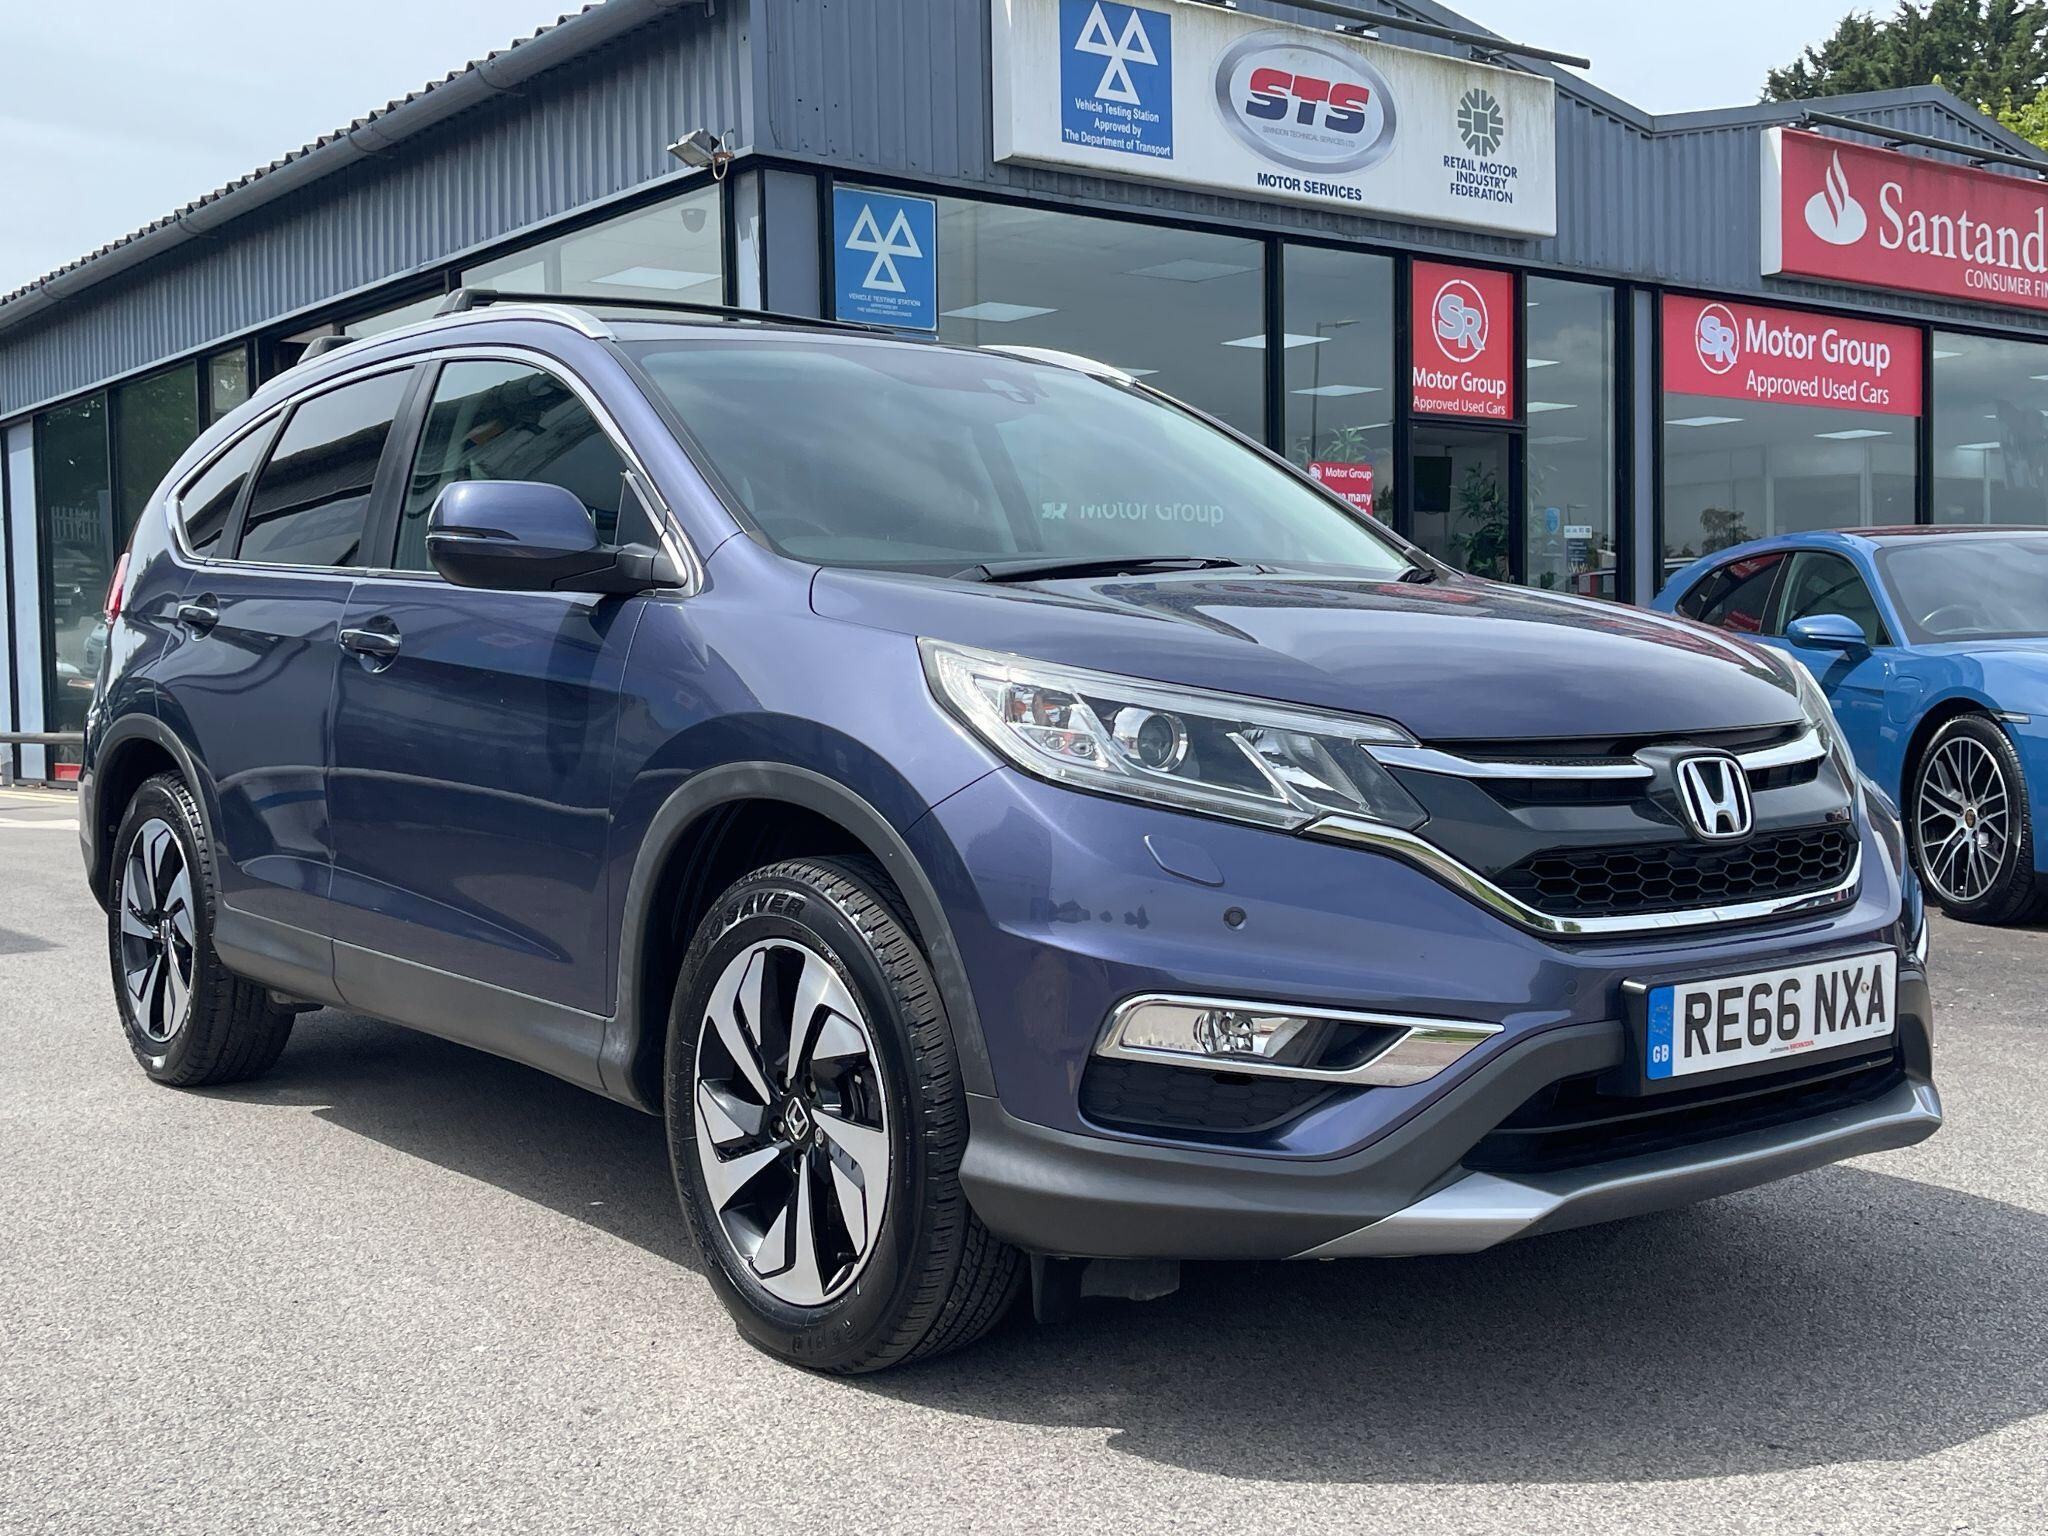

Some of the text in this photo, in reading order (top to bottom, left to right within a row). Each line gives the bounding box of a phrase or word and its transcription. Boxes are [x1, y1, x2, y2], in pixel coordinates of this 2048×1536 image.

[1074, 97, 1160, 123] Vehicle Testing Station
[1246, 68, 1370, 134] STS
[1094, 117, 1142, 138] Approved by
[1064, 128, 1171, 156] The Department of Transport
[1443, 155, 1518, 179] RETAIL MOTOR
[1456, 170, 1508, 189] INDUSTRY
[1257, 172, 1363, 201] MOTOR SERVICES
[1450, 182, 1513, 204] FEDERATION
[1965, 268, 2032, 296] CONSUMER
[849, 292, 921, 307] VEHICLE TESTING STATION
[1746, 318, 1816, 360] Motor
[1822, 328, 1890, 376] Group
[1413, 366, 1506, 399] Motor Group
[1746, 369, 1889, 405] Approved Used Cars
[1413, 395, 1506, 415] Approved Used Cars
[1325, 467, 1347, 478] Motor
[1349, 468, 1372, 481] Group
[1347, 493, 1371, 505] many
[1154, 502, 1224, 527] Group
[1684, 964, 1886, 1058] RE66 NXA
[1653, 1044, 1670, 1063] GB
